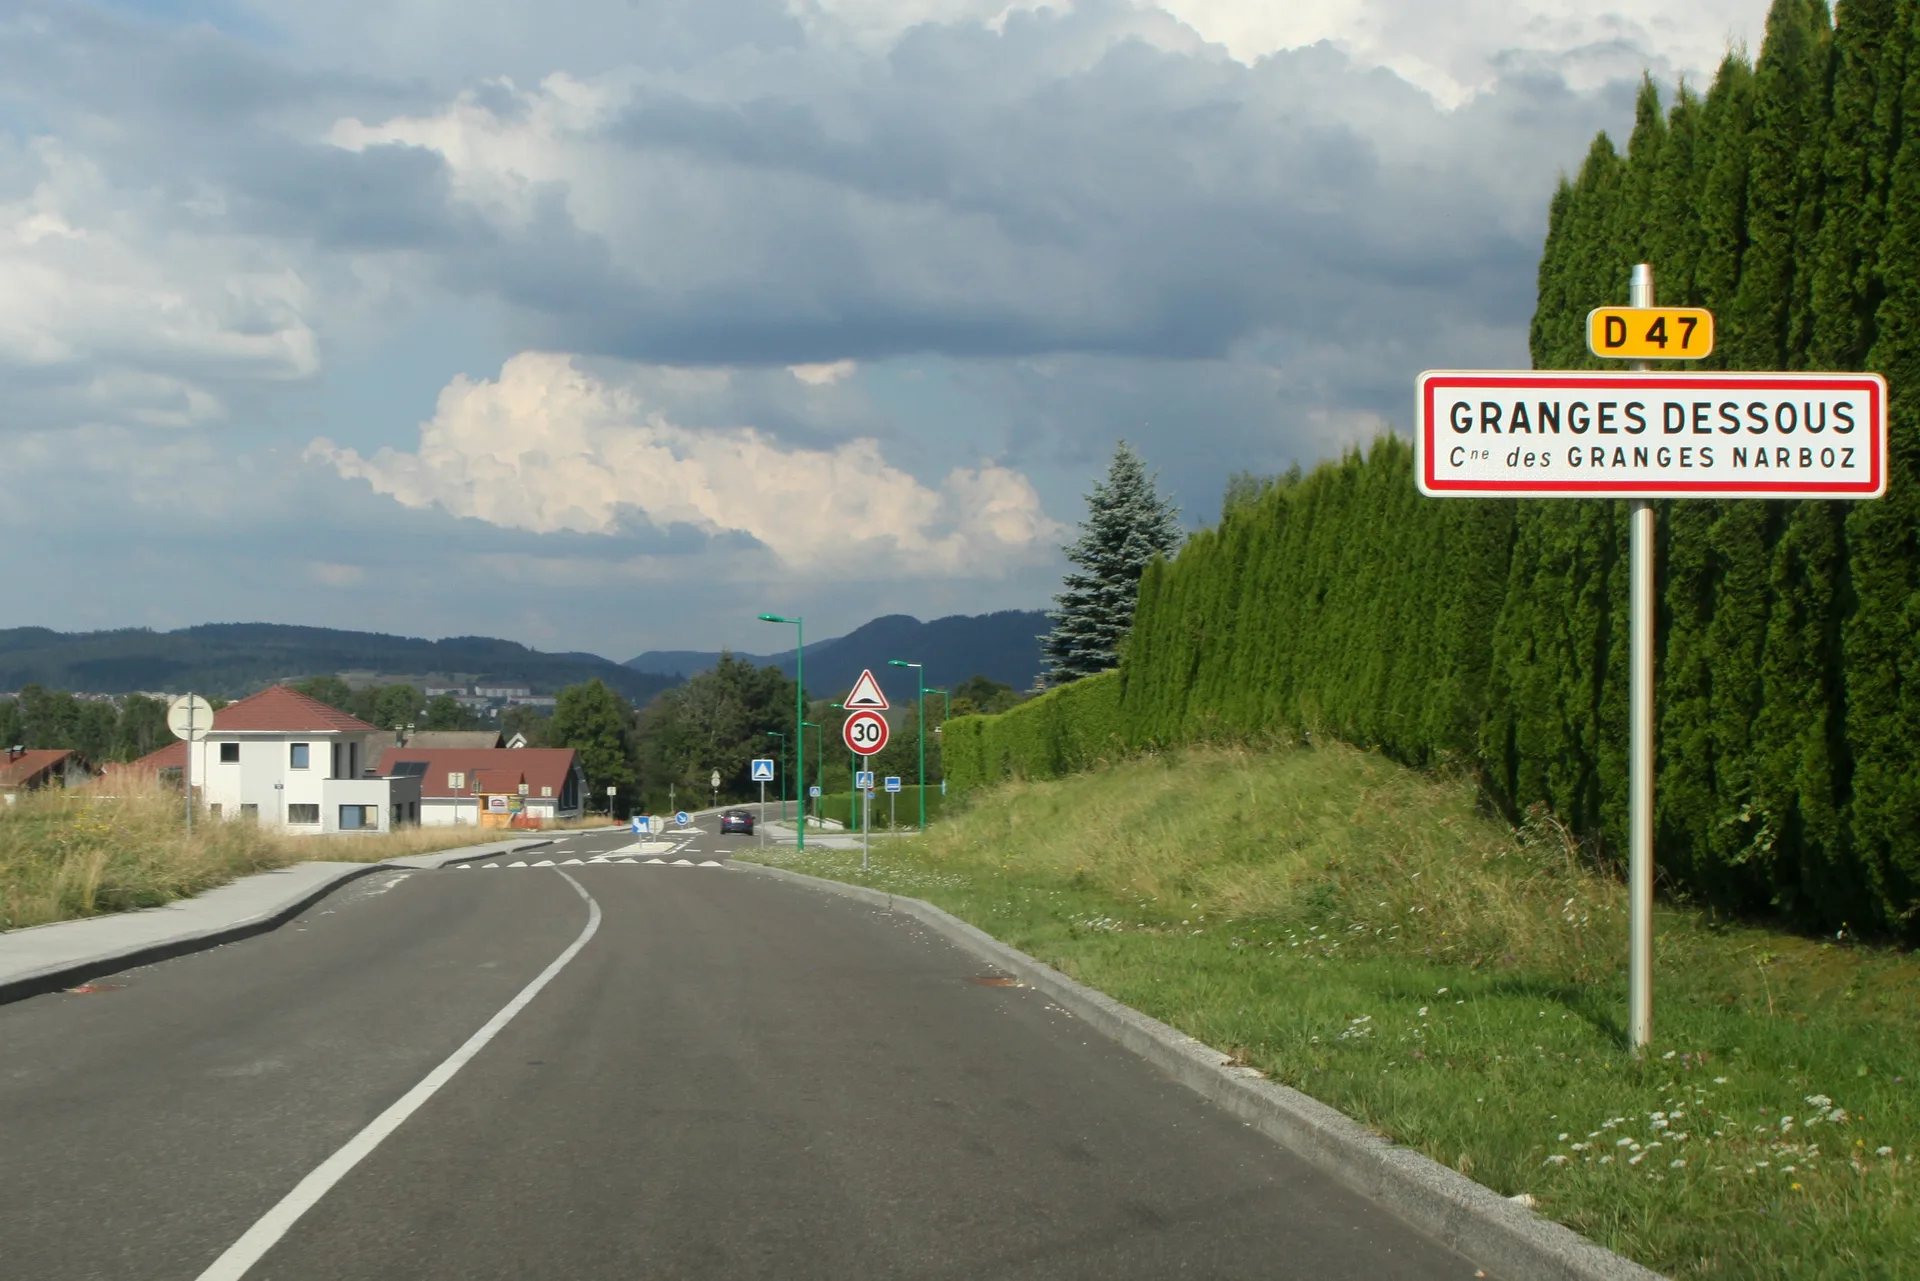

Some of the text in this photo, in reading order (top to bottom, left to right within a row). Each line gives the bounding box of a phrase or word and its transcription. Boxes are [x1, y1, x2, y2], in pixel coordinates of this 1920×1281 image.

[1605, 315, 1698, 350] D 47
[1450, 401, 1855, 435] GRANGES DESSOUS
[1450, 446, 1855, 469] Cne des GRANGES NARBOZ
[853, 723, 879, 742] 30
